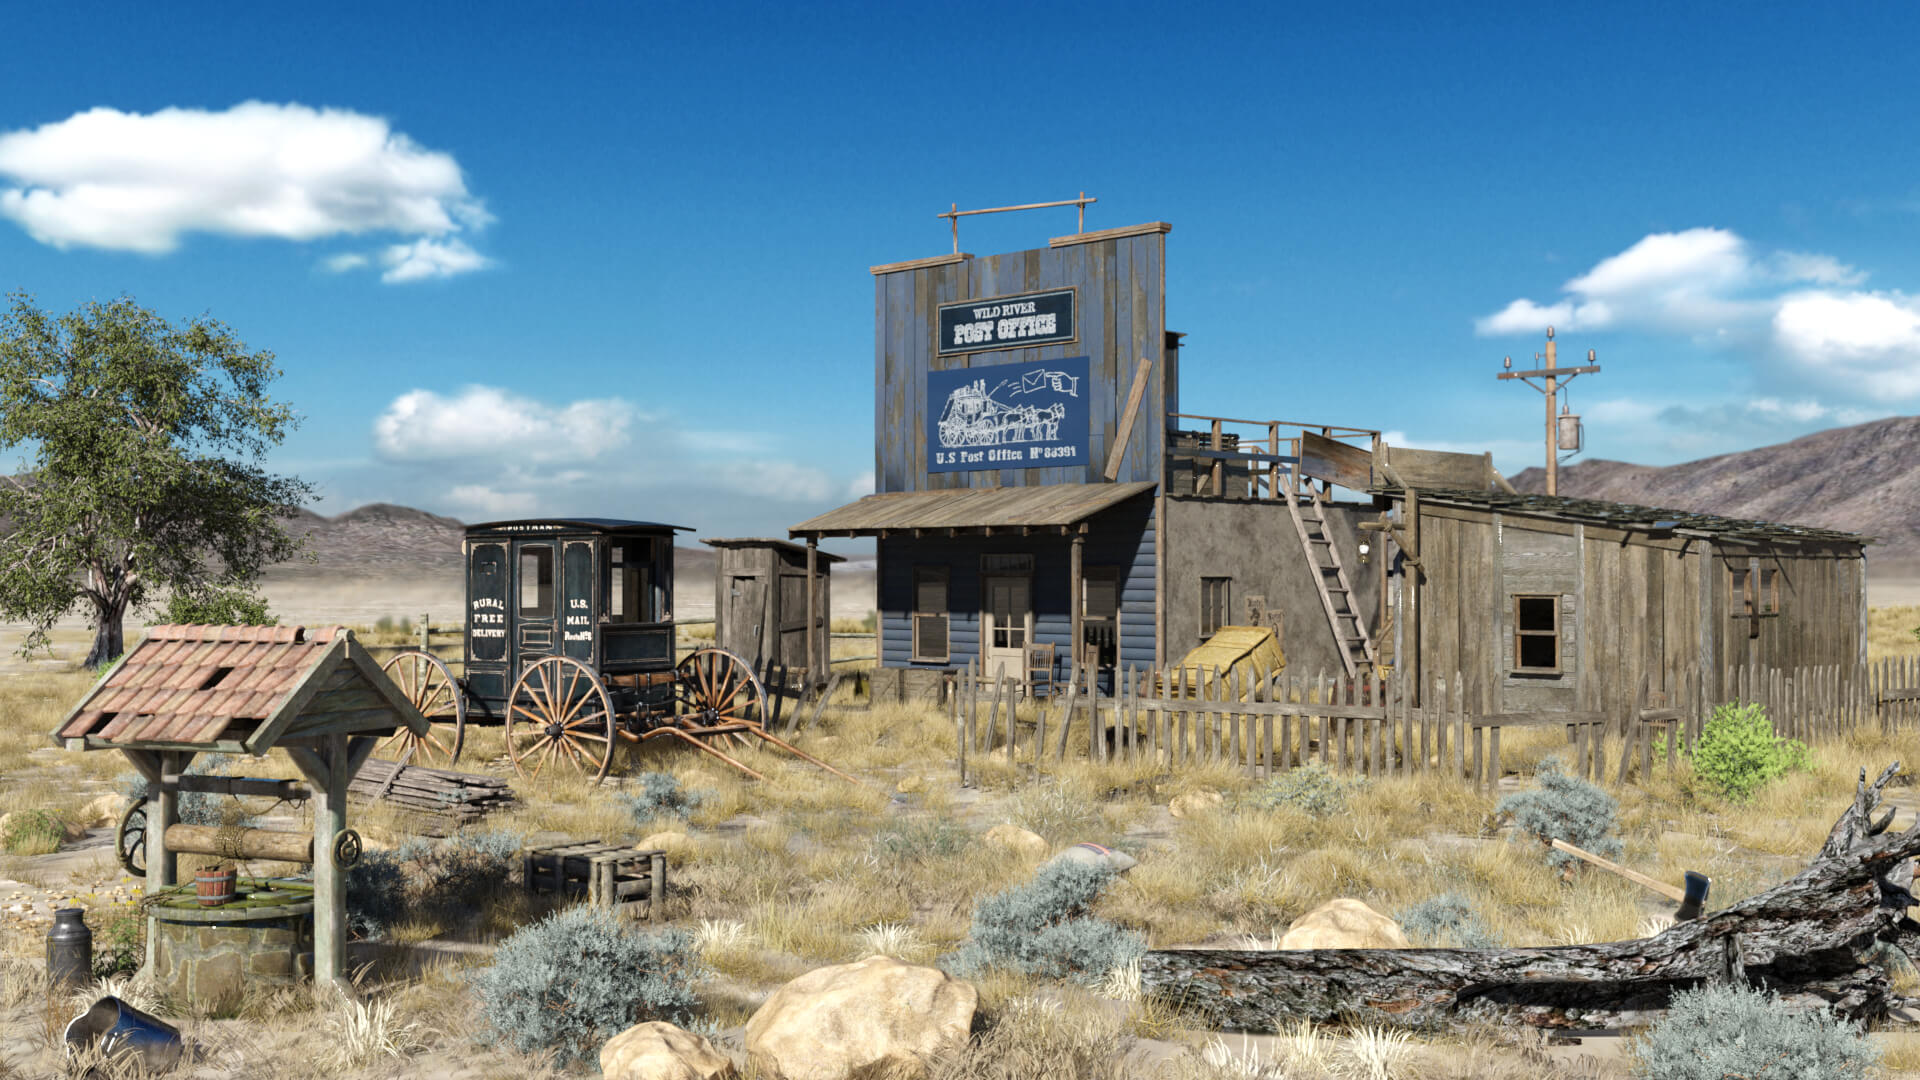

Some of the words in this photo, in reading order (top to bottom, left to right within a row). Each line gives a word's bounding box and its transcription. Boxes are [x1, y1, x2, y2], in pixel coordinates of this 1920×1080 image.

[973, 306, 1000, 320] WILD
[1001, 301, 1036, 316] RIVER
[953, 320, 994, 345] POST
[997, 313, 1057, 339] OFFICE
[960, 450, 984, 463] Post
[988, 449, 1023, 462] Office
[473, 598, 504, 610] RURAL
[570, 599, 588, 609] U.S.
[474, 613, 504, 624] FREE
[566, 615, 590, 625] MAIL
[472, 628, 505, 638] DELIVERY
